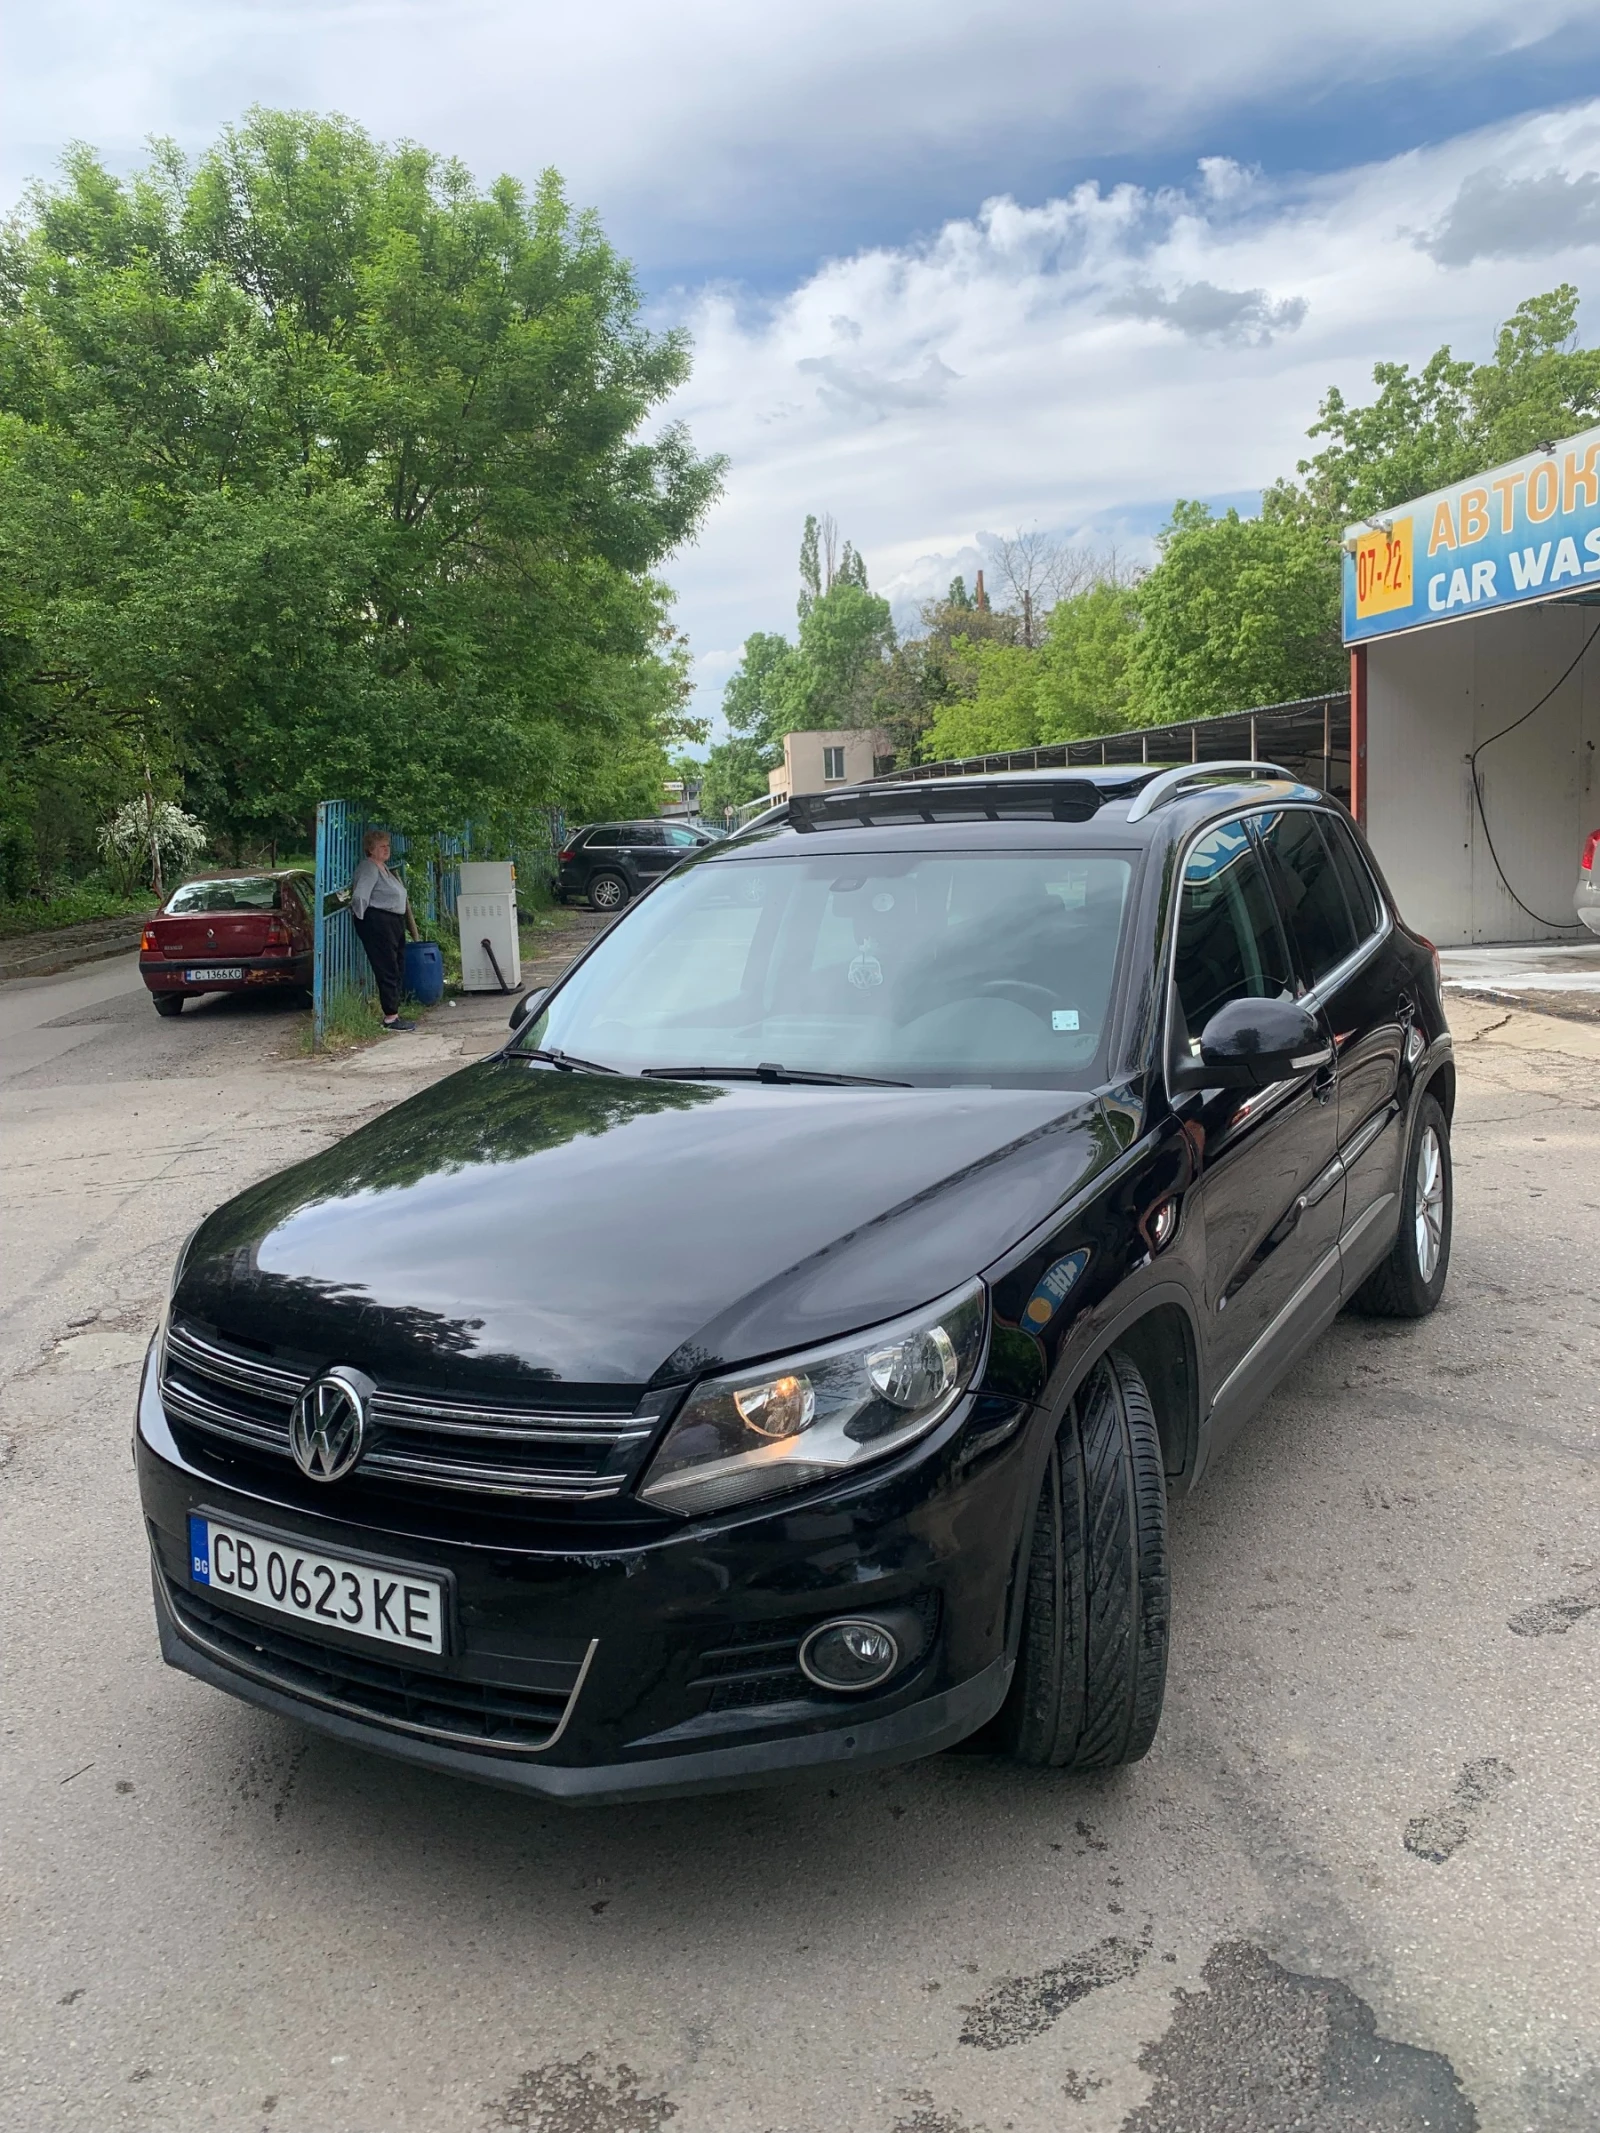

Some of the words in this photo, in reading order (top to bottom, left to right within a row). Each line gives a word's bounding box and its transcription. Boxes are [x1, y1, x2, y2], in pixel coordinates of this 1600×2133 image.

[1428, 442, 1600, 557] АВТОК
[1428, 560, 1497, 612] CAR
[1508, 527, 1600, 591] WAS
[193, 1557, 208, 1575] BG
